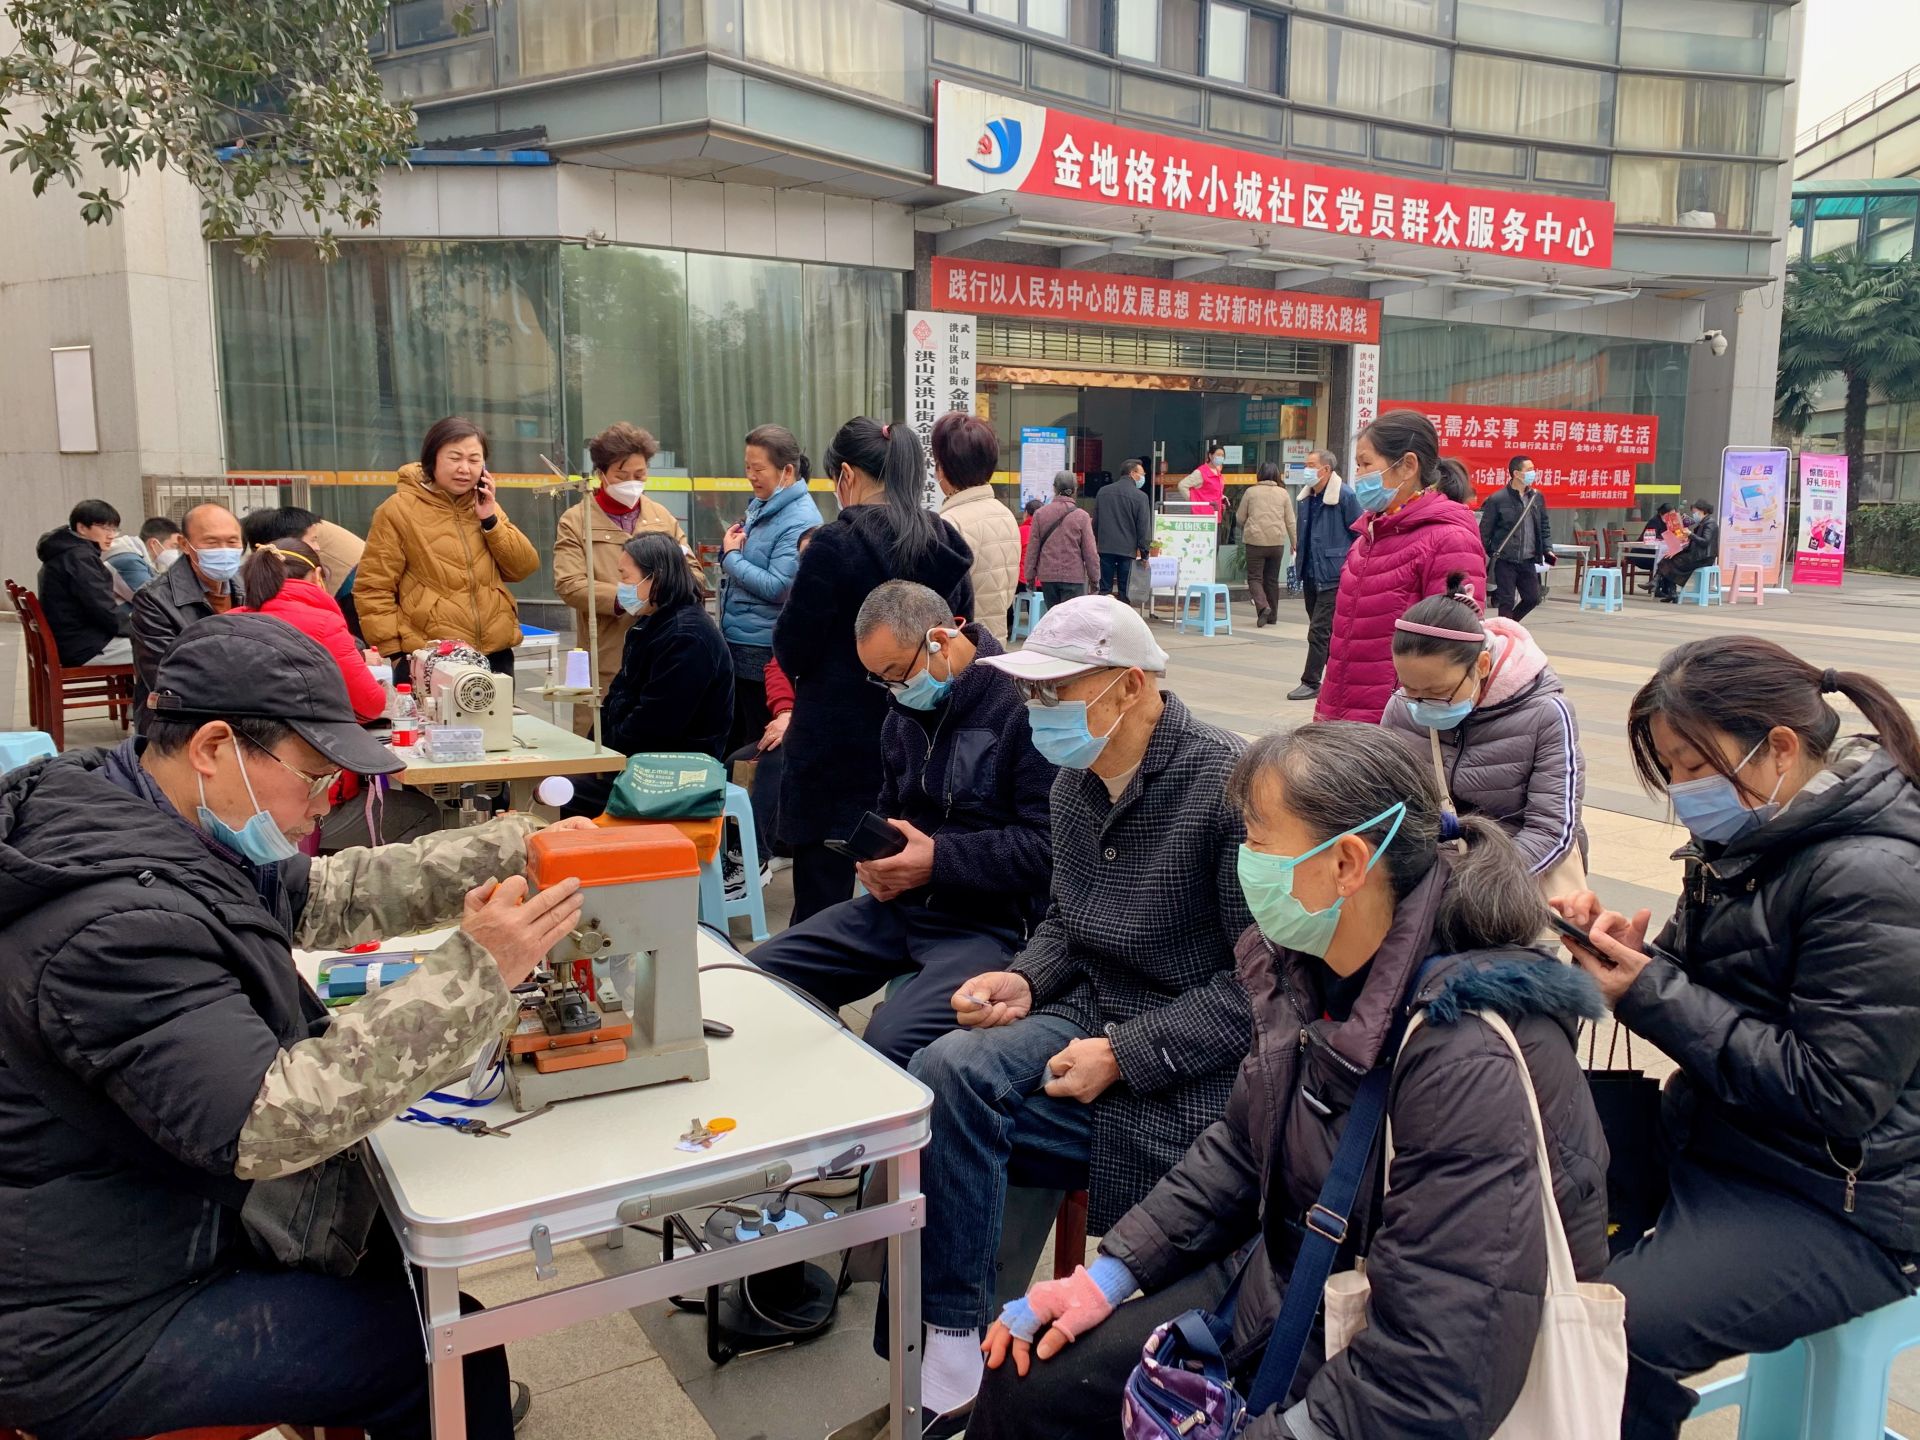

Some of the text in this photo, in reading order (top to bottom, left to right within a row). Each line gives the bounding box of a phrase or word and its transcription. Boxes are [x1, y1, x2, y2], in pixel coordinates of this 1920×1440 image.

[1052, 133, 1596, 258] 金地格林小城社区党员群众服务中心
[948, 268, 1368, 335] 践行以人民为中心的发展思想 走好新时代党的群众路线
[949, 322, 959, 386] 洪山区洪山街
[1533, 420, 1651, 446] 共同缔造新生活
